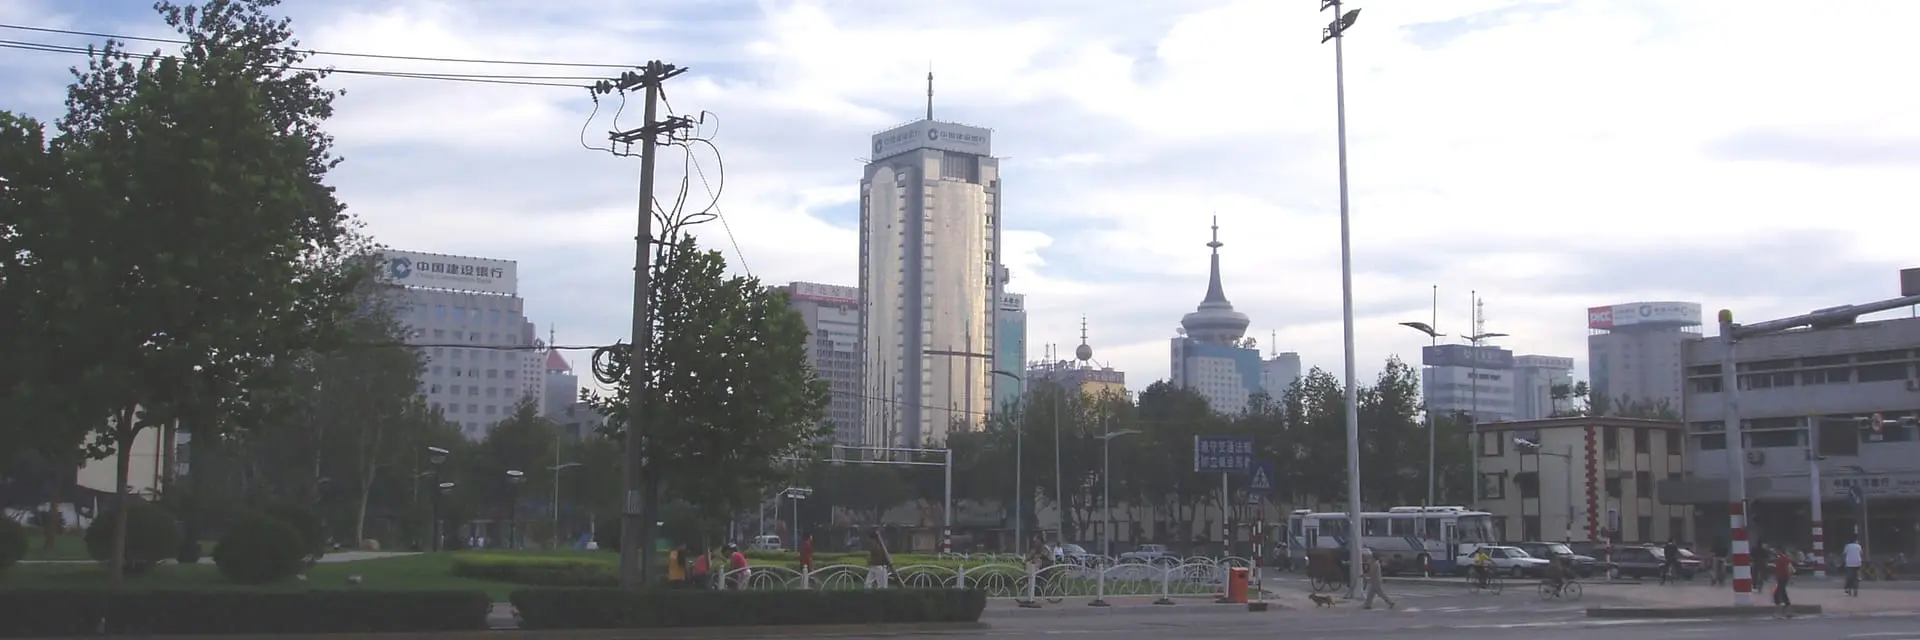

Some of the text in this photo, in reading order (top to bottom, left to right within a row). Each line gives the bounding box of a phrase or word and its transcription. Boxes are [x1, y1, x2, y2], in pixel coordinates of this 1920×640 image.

[416, 261, 503, 279] 中国建设银行
